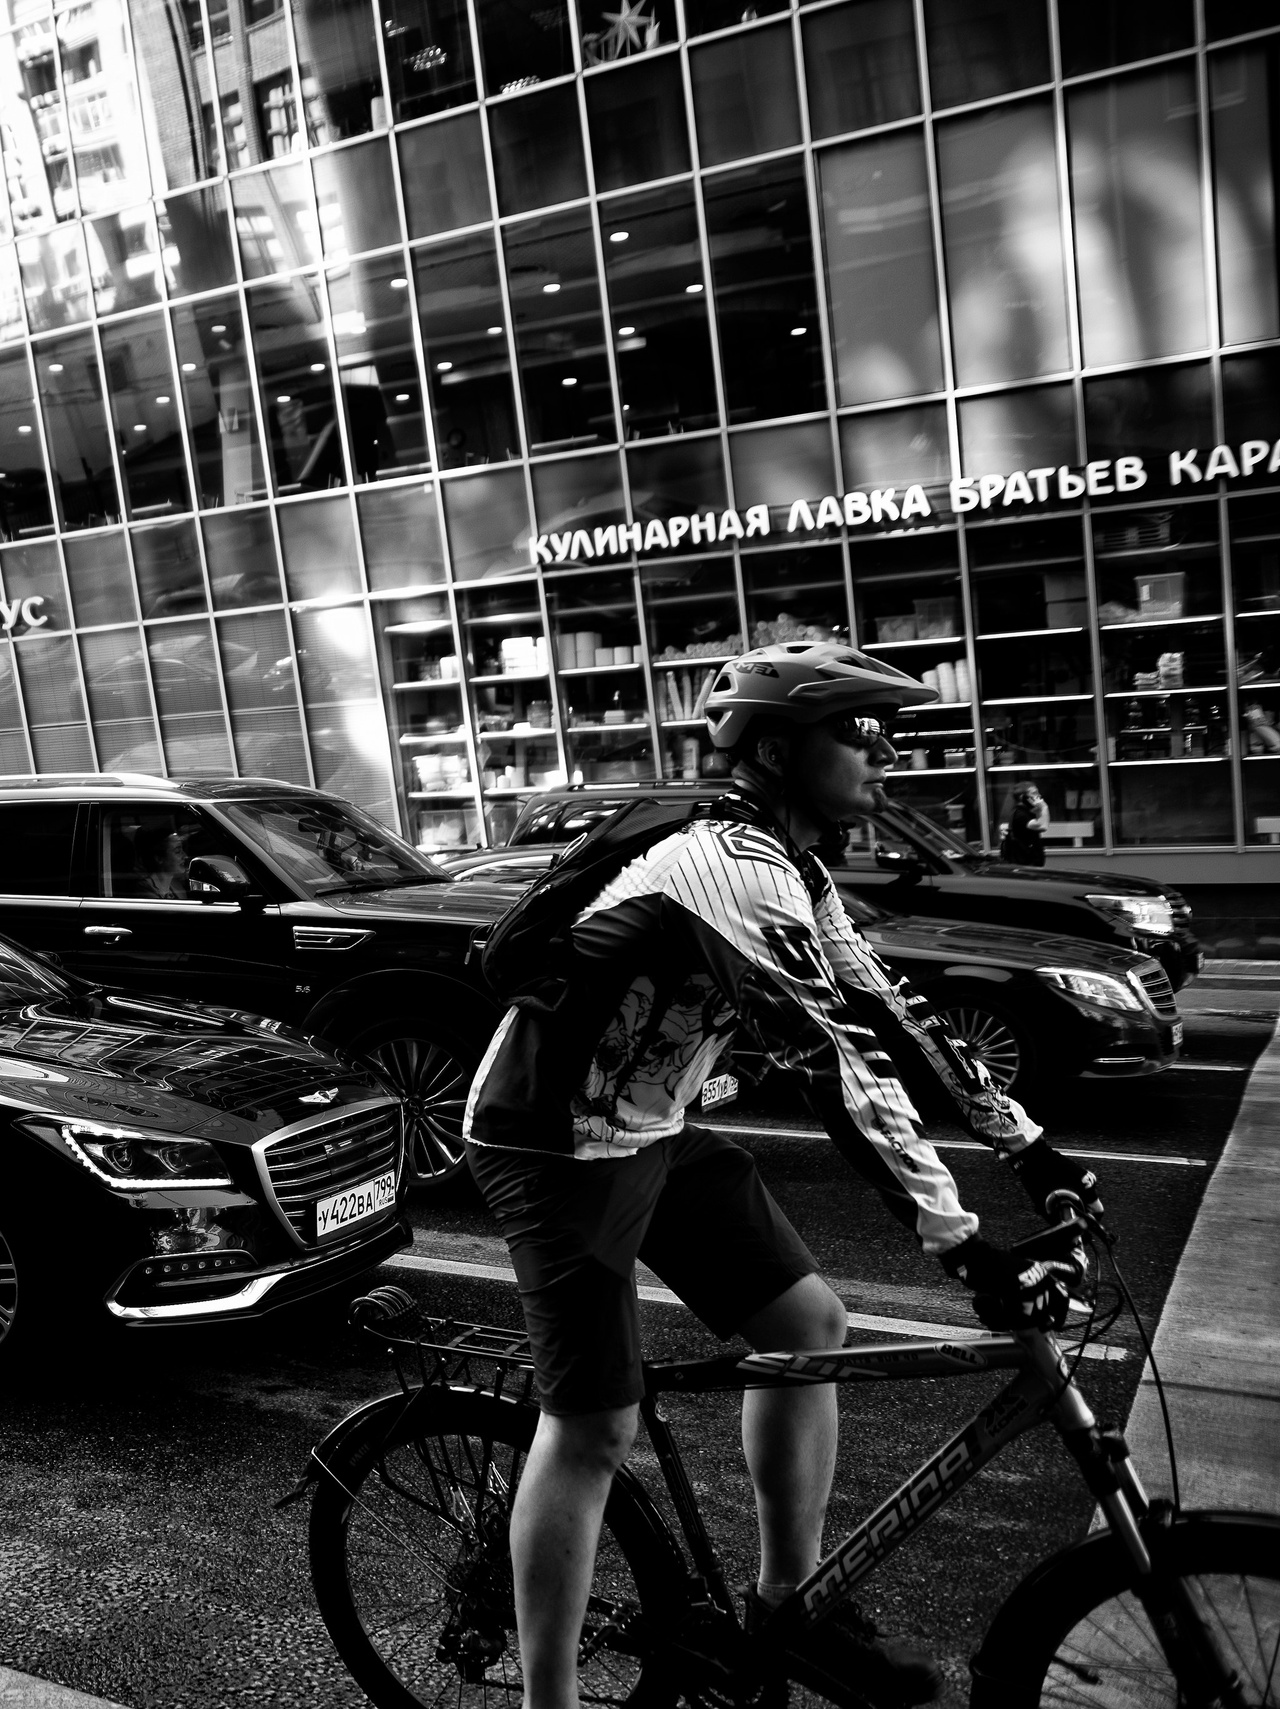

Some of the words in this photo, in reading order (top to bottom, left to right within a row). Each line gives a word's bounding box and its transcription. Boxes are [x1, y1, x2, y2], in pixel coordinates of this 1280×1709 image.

[528, 502, 772, 566] КУЛИНАРНАЯ
[785, 483, 932, 532] ЛАВКА
[948, 454, 1148, 514] БРАТЬЕВ
[735, 662, 773, 675] MET
[321, 1191, 373, 1231] У422ВА
[940, 1344, 978, 1365] BELL
[803, 1440, 974, 1621] MERIDA
